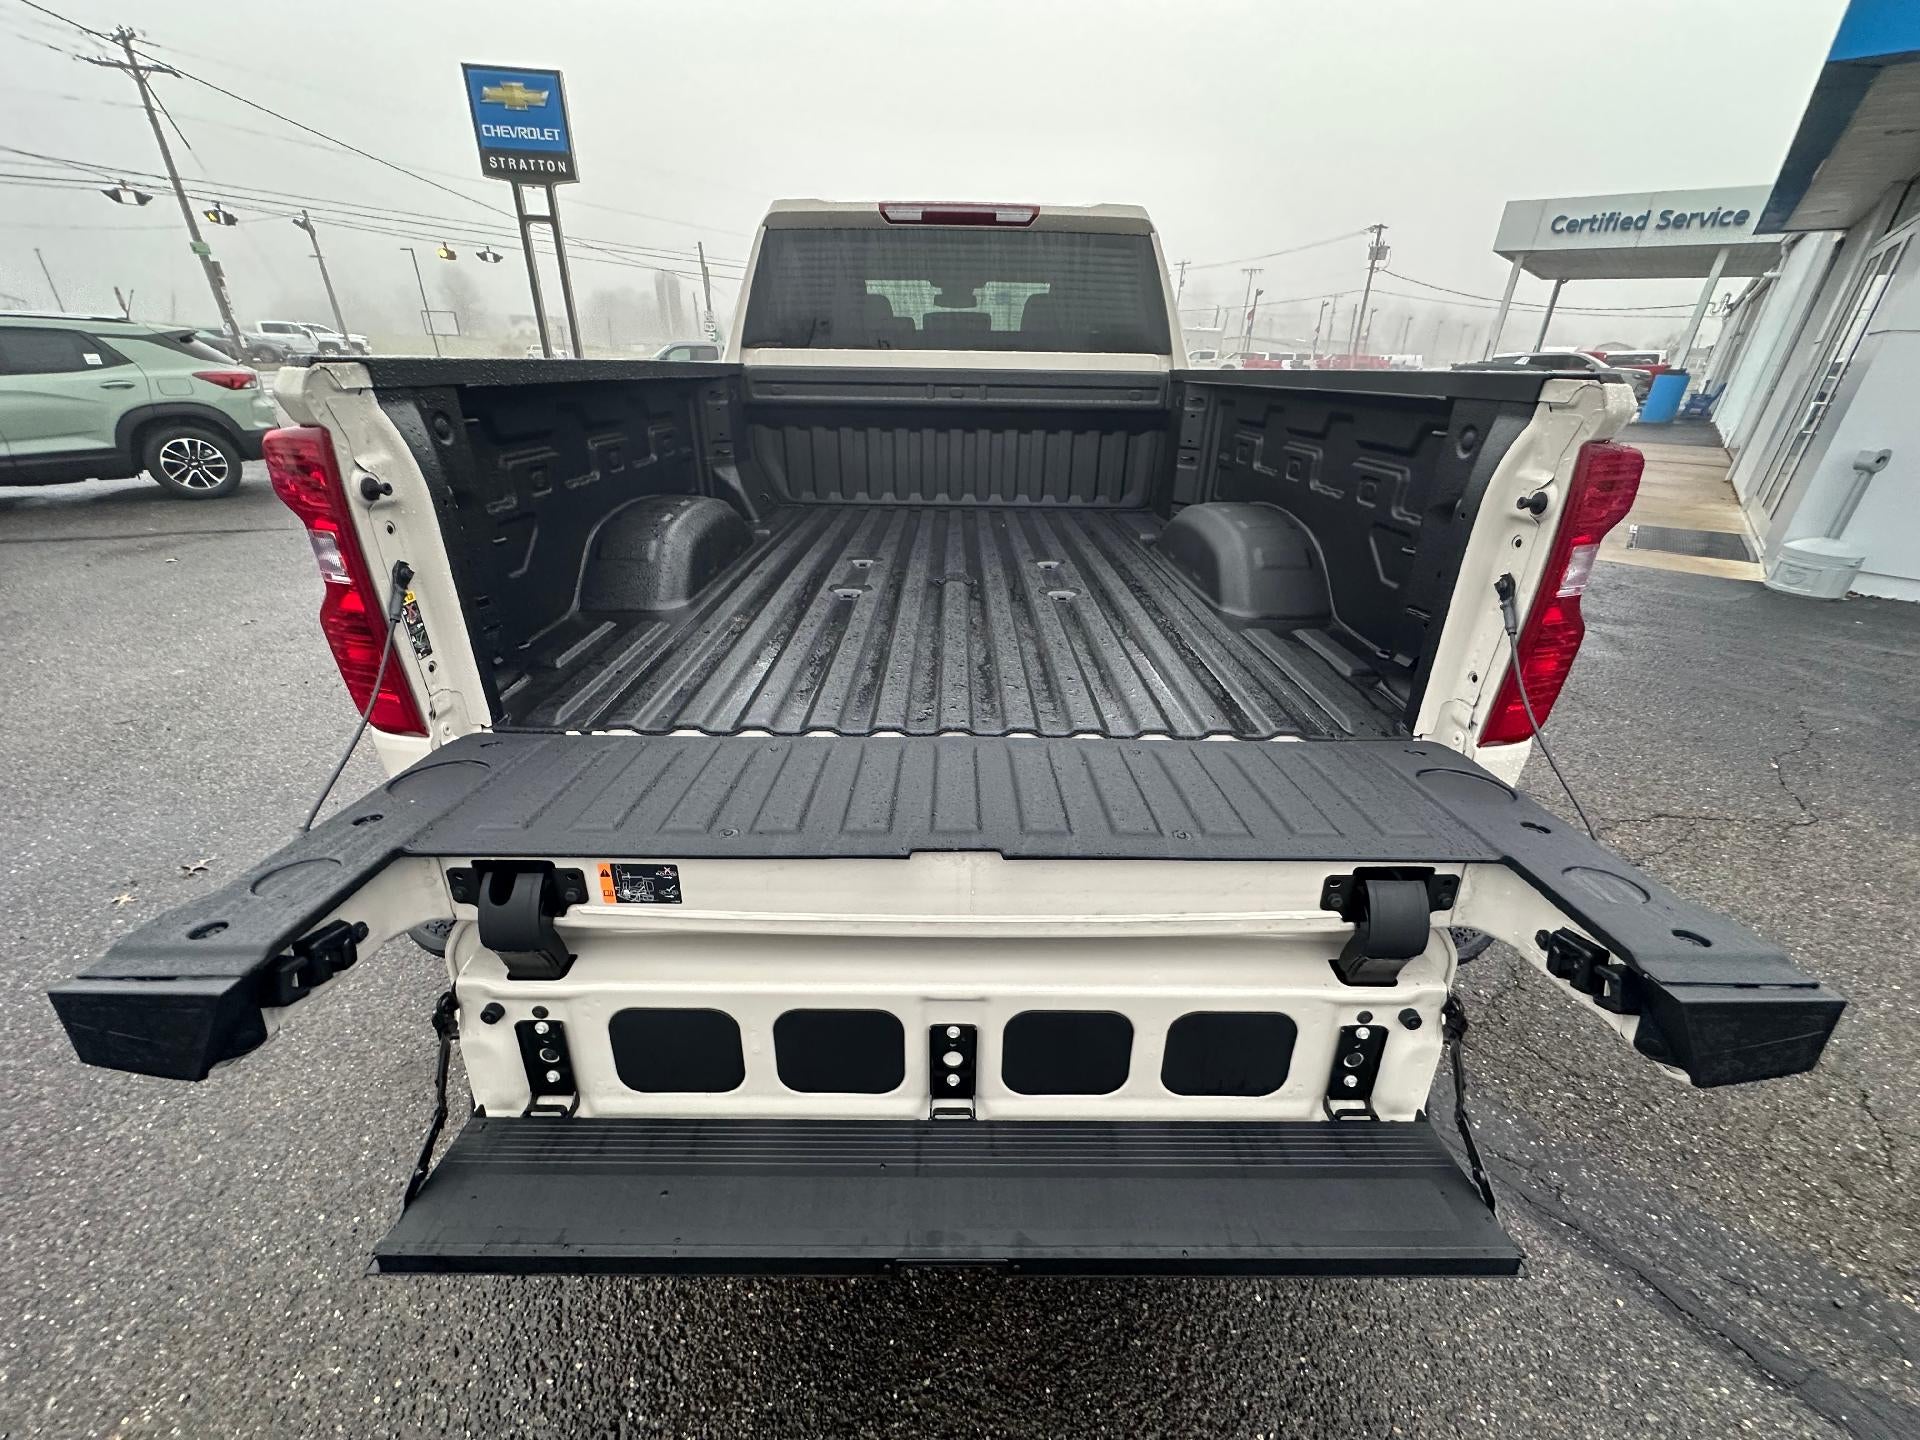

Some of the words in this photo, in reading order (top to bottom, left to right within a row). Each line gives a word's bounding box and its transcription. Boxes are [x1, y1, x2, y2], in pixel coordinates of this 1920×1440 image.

[481, 124, 560, 140] CHEVROLET
[489, 156, 567, 172] STRATTON
[1551, 211, 1651, 233] Certified
[1656, 207, 1750, 230] Service
